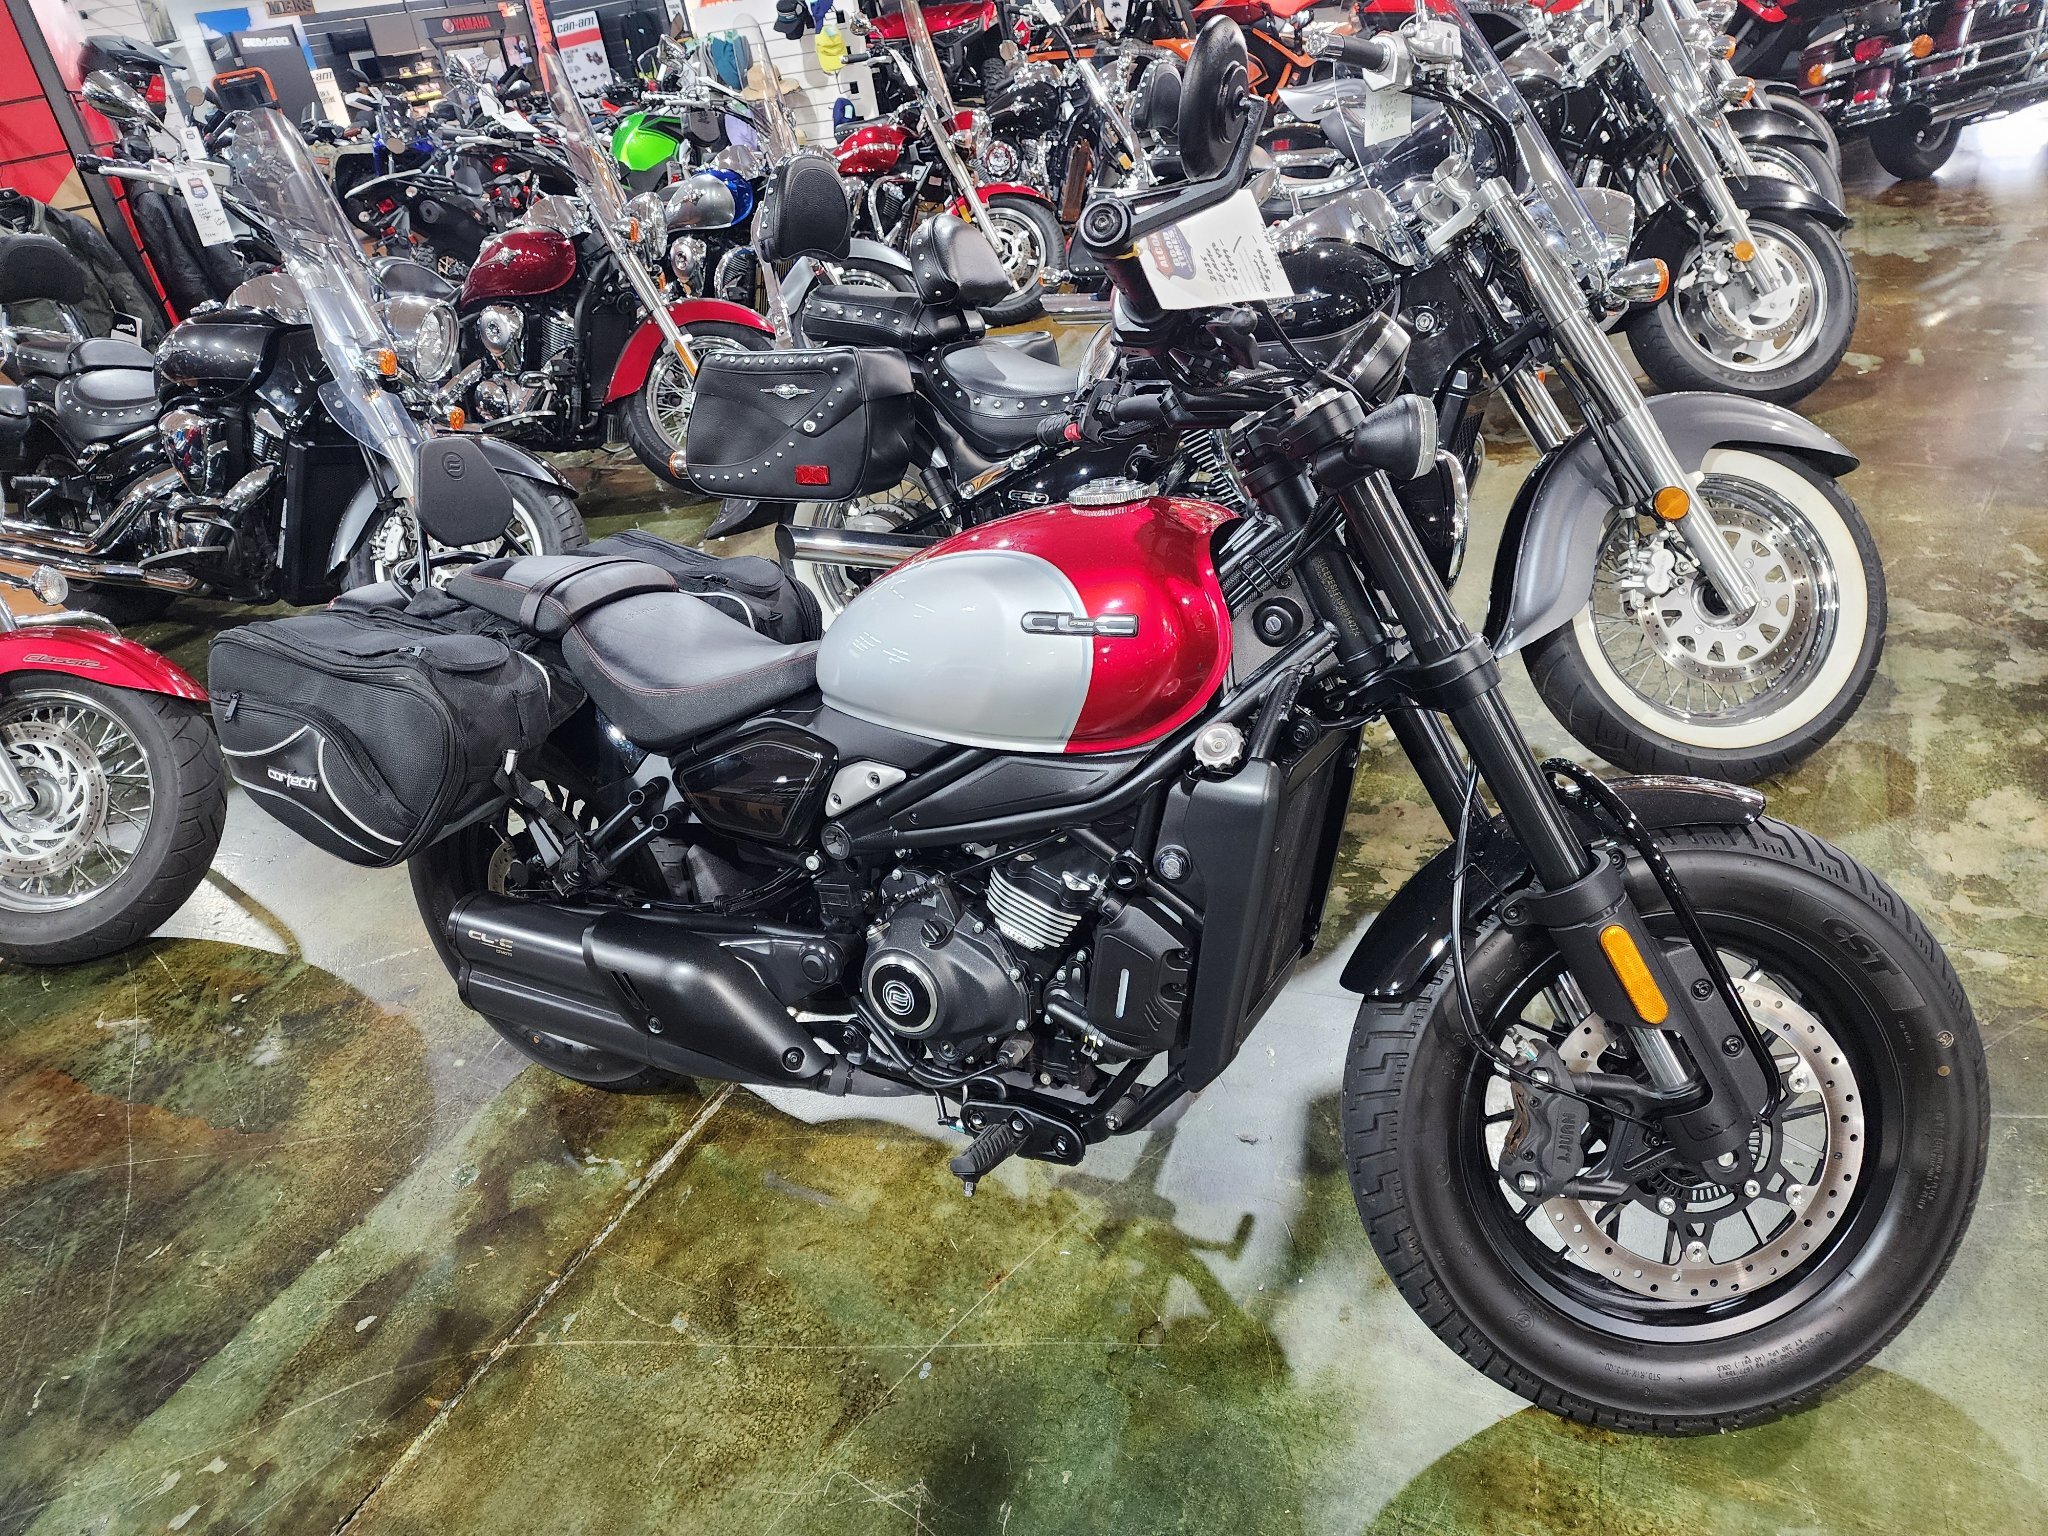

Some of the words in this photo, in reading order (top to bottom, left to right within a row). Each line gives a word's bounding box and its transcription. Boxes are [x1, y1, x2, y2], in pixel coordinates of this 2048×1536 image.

[452, 15, 492, 31] YAMAHA
[557, 16, 595, 34] can-am
[1163, 231, 1182, 266] GOOD
[1168, 228, 1187, 267] TIMES
[267, 769, 317, 792] cortech
[1821, 917, 1902, 976] CST
